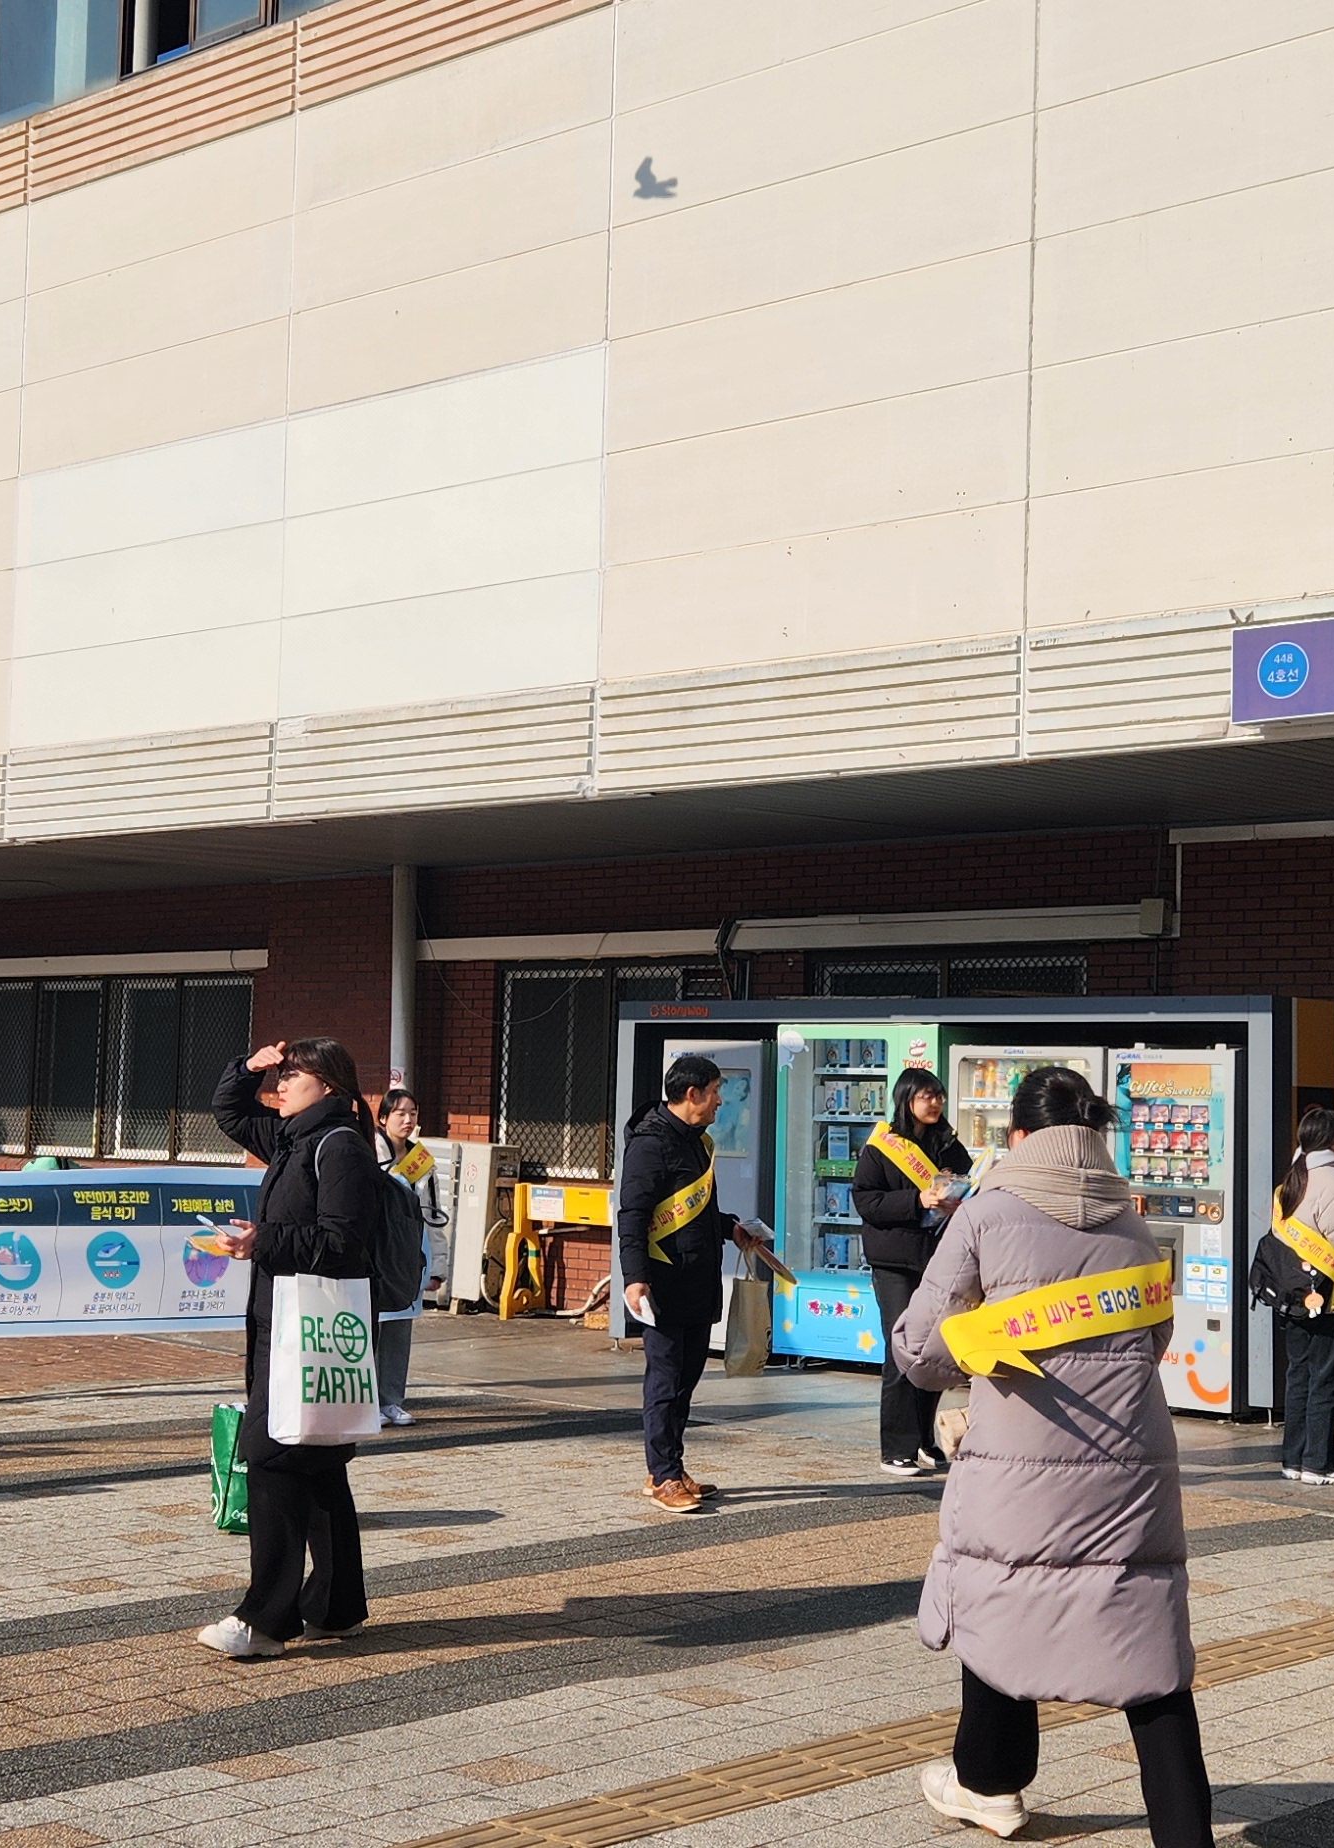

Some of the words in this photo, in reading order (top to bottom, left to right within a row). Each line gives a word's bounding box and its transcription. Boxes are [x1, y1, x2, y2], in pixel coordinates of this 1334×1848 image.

[1274, 653, 1293, 664] 448
[1267, 668, 1299, 683] 4호선
[662, 1005, 709, 1018] Storyway
[1129, 1080, 1166, 1096] Coffee
[464, 1184, 475, 1193] LG
[91, 1206, 112, 1220] 음식
[114, 1206, 136, 1220] 먹기
[214, 1199, 235, 1213] 실천
[1042, 1294, 1094, 1328] 마스크
[301, 1315, 333, 1354] RE:
[302, 1366, 374, 1404] EARTH
